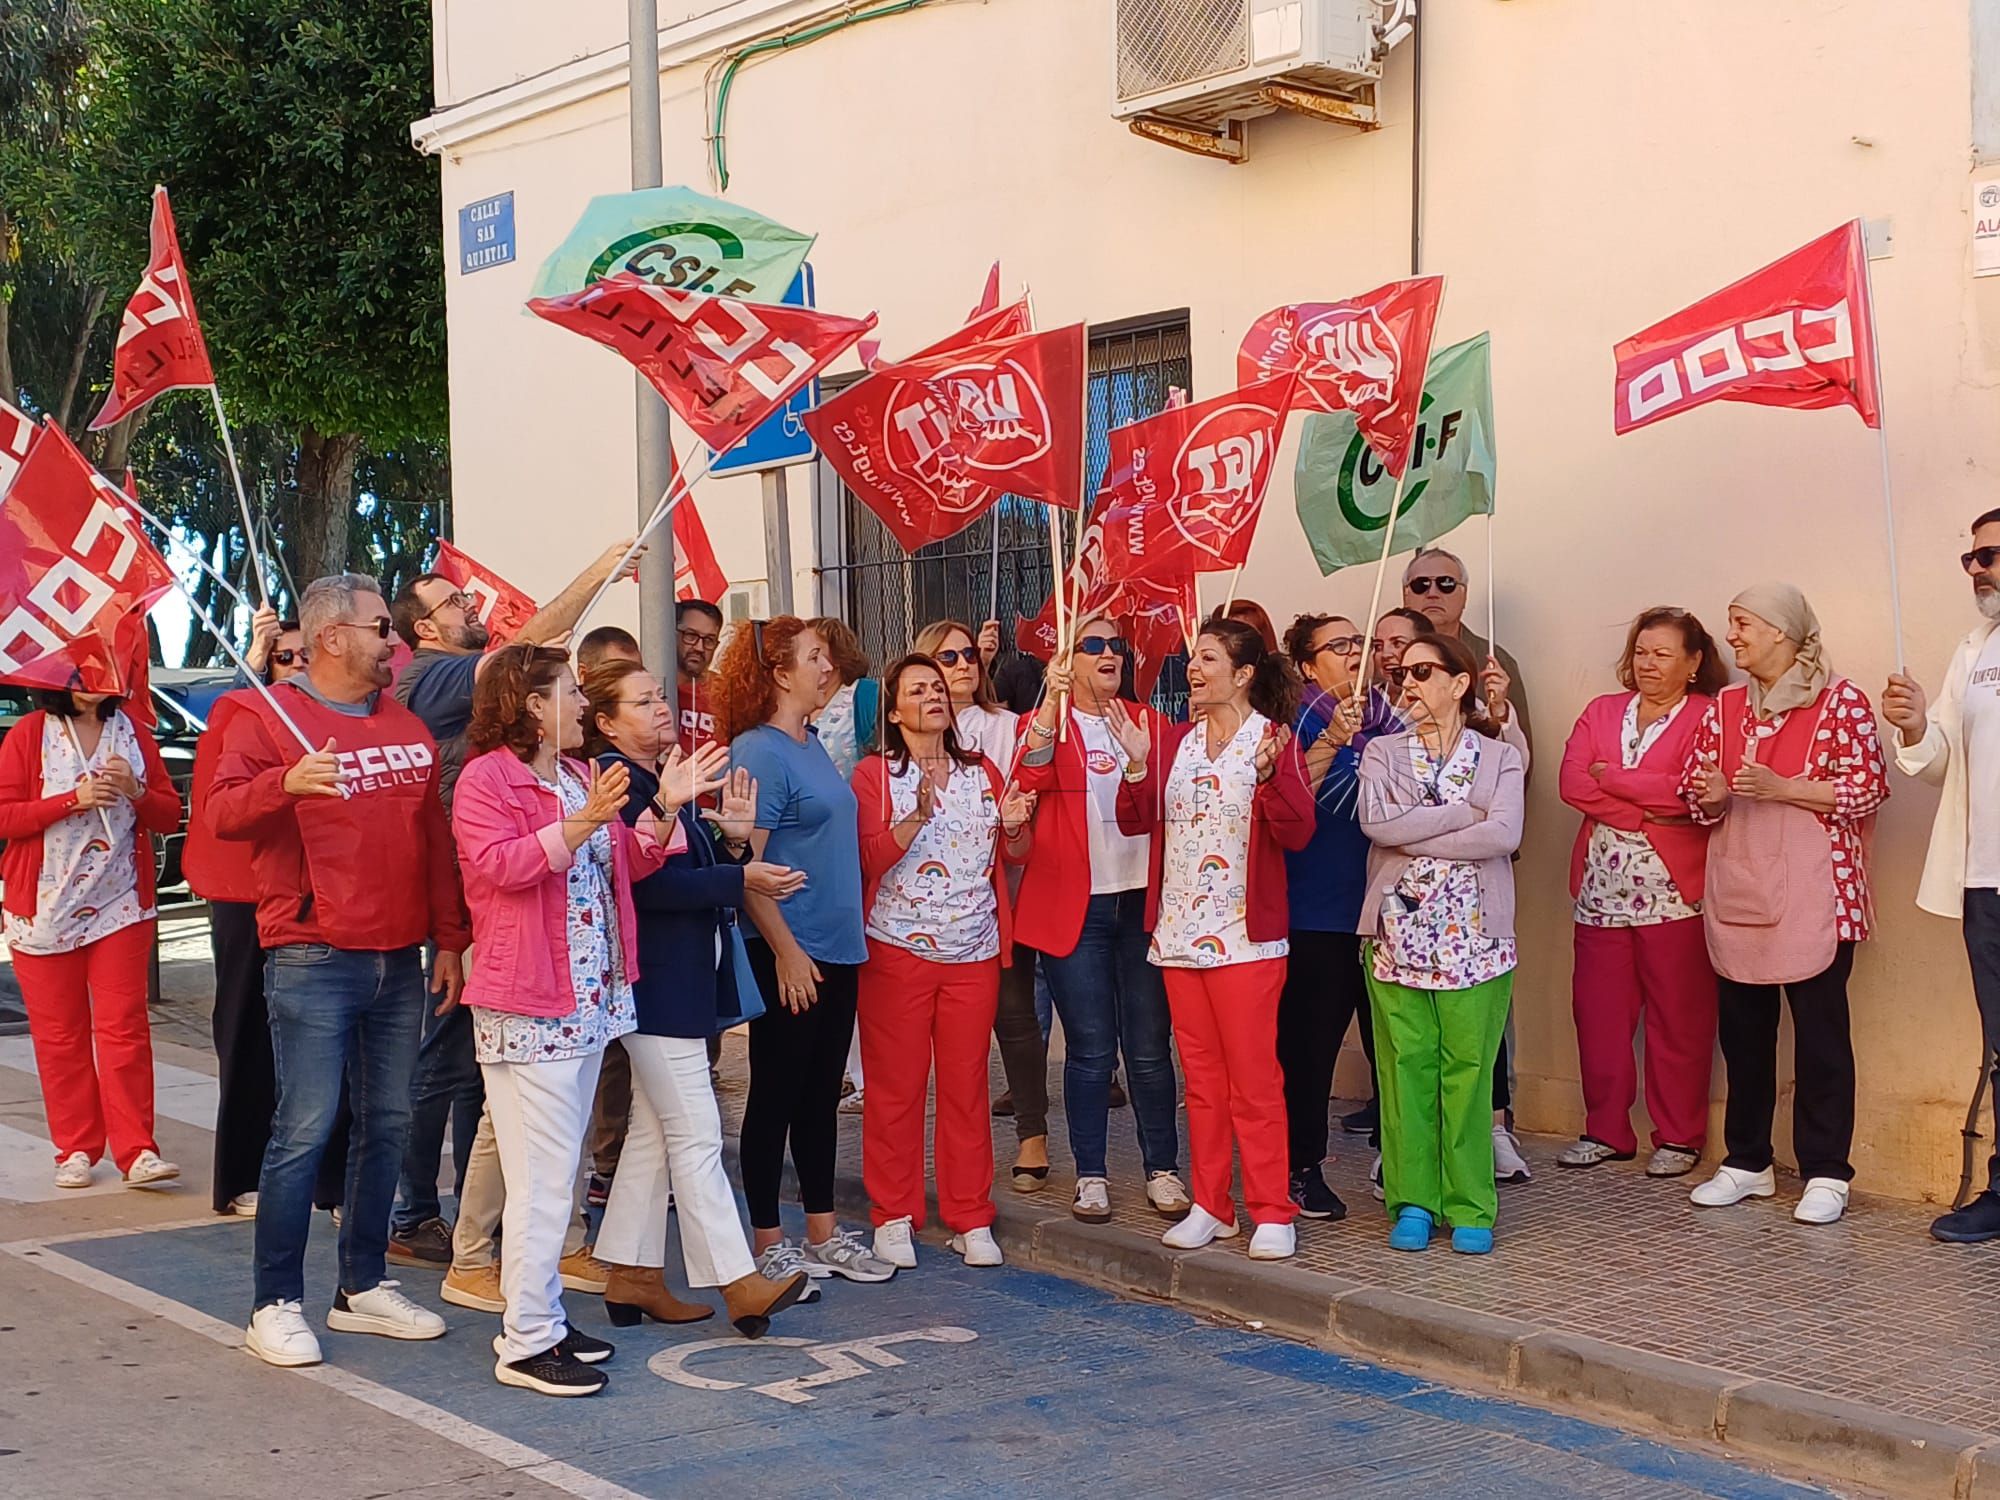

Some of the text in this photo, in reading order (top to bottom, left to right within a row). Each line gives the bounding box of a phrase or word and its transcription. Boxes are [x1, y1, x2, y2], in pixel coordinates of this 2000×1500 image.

[470, 200, 501, 222] CALLE
[477, 224, 496, 243] SAN
[466, 243, 508, 268] QUINTIN
